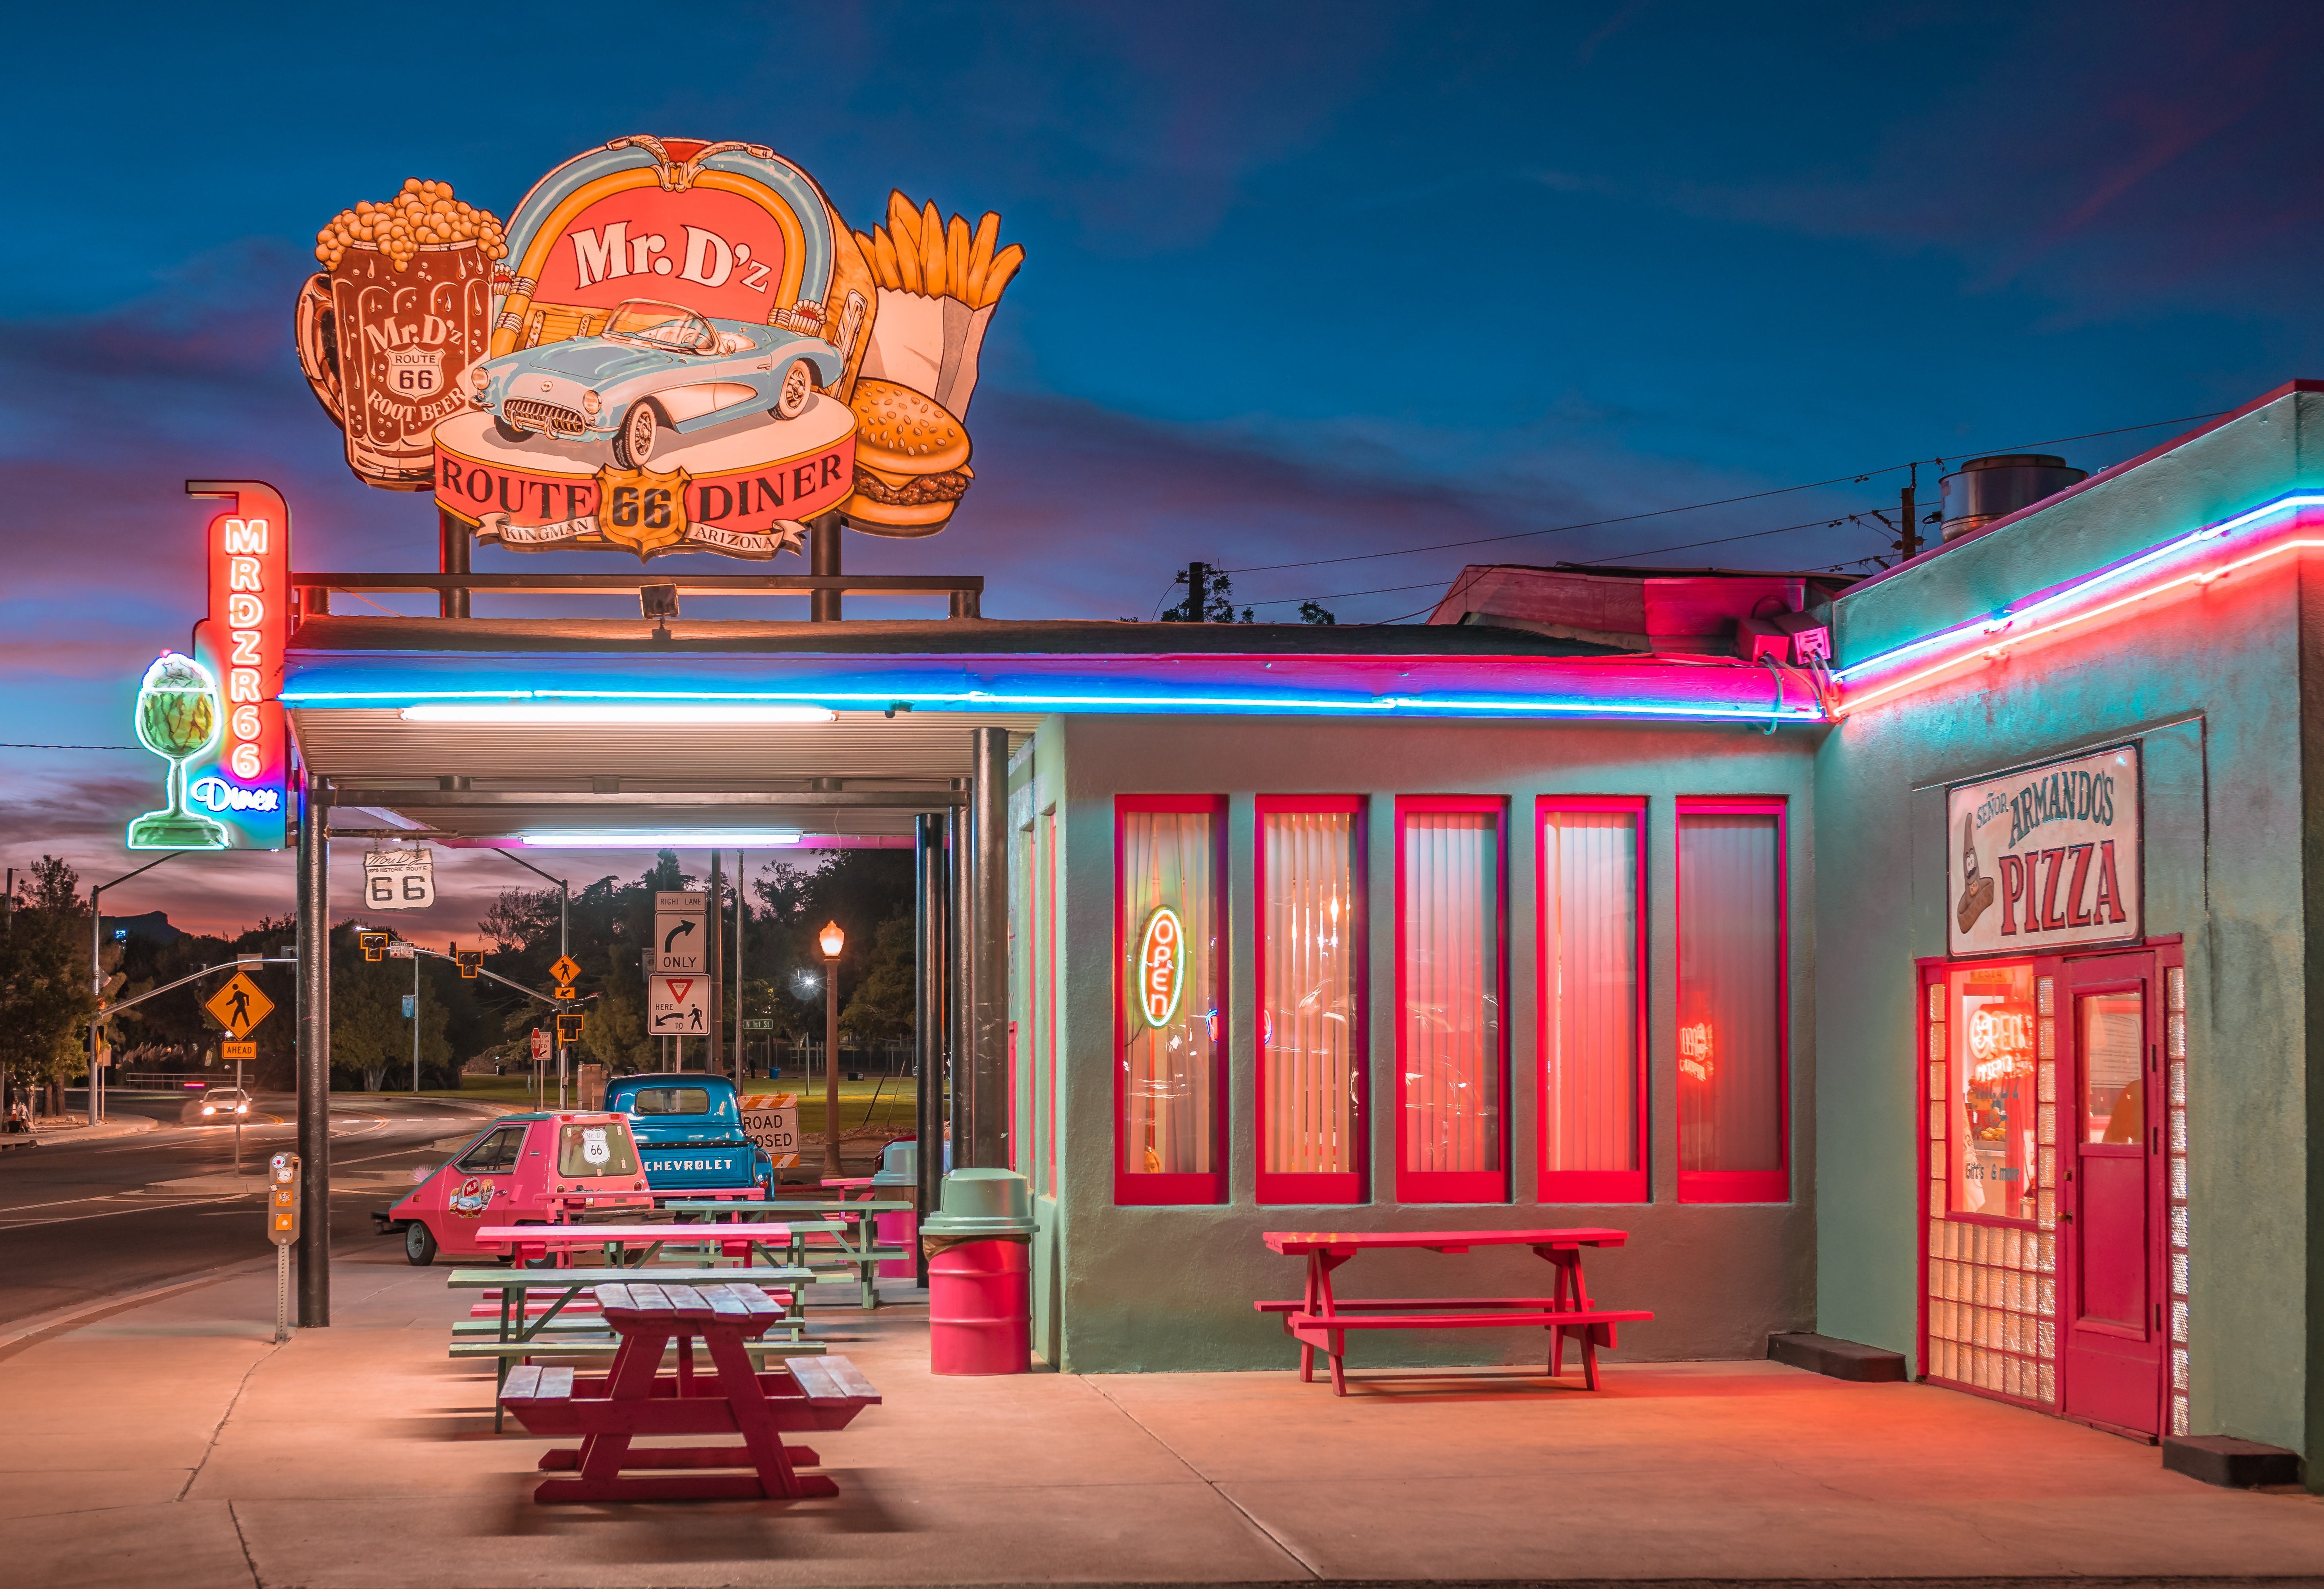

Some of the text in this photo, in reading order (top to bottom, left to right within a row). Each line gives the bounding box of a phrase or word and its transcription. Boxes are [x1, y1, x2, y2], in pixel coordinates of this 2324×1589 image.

[567, 220, 772, 294] Mr. D'z
[364, 314, 463, 354] Mr. D'z
[395, 355, 435, 363] ROUTE
[399, 370, 433, 390] 66
[368, 387, 466, 422] ROOT BEER
[441, 454, 842, 528] ROUTE 66 DINER
[505, 519, 776, 549] KINGMAN ARIZONA
[191, 777, 281, 813] Diner
[1977, 792, 2009, 830] SEÑOR
[369, 855, 395, 865] Mr.
[371, 876, 425, 901] 66
[1999, 839, 2126, 936] PIZZA
[663, 957, 697, 968] ONLY
[743, 1115, 783, 1130] ROAD
[591, 1144, 602, 1155] 66
[755, 1133, 792, 1148] OSED
[644, 1160, 733, 1171] CHEVROLET
